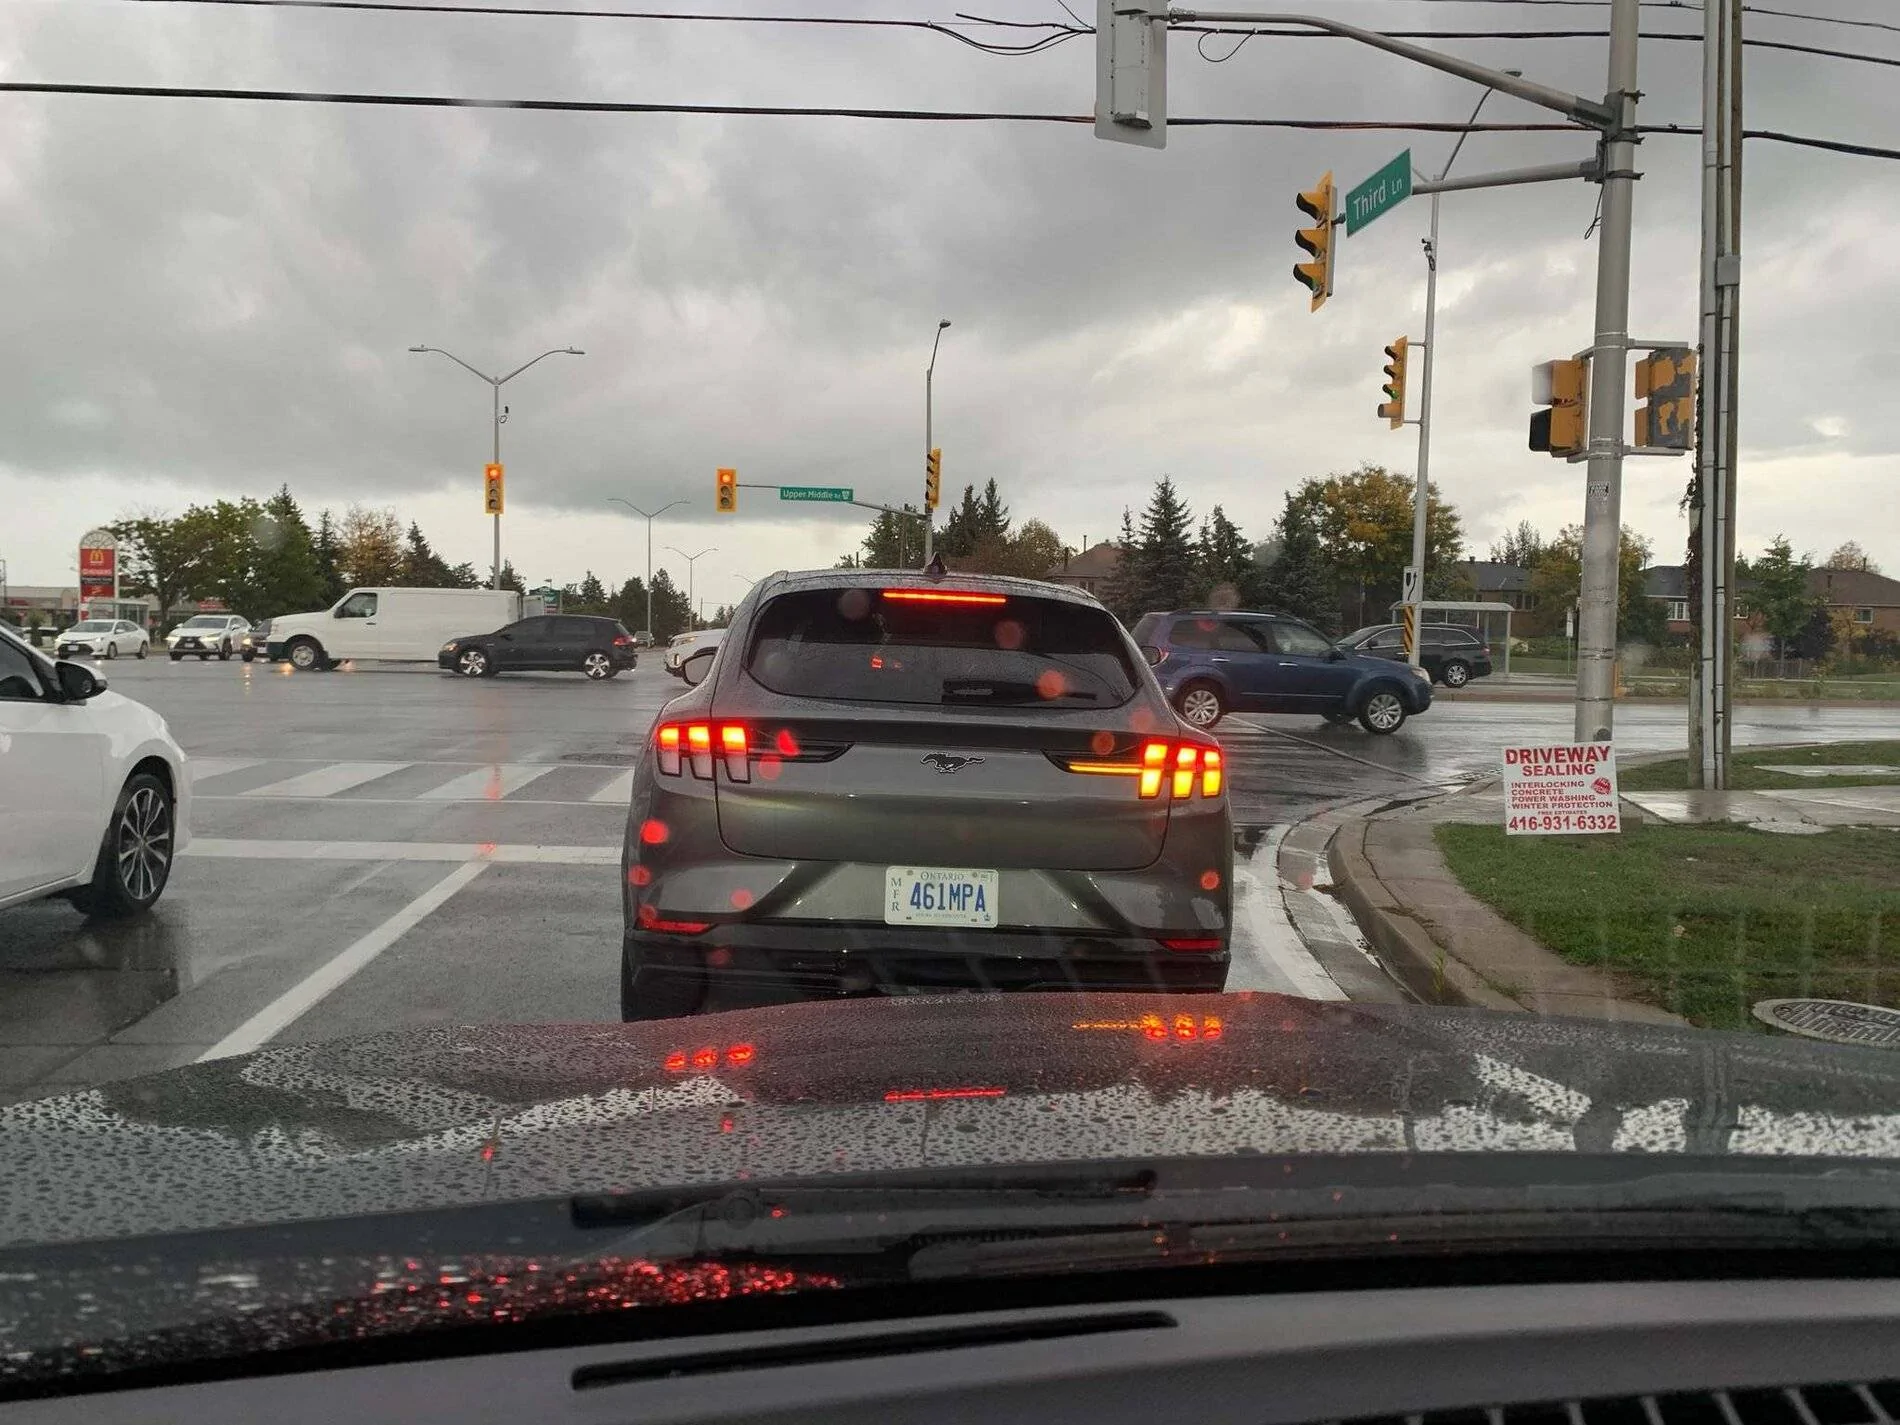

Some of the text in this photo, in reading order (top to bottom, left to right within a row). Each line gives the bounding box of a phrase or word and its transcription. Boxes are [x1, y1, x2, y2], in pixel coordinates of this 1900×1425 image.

[1353, 178, 1402, 220] Third Ln
[783, 490, 805, 499] Upper
[808, 490, 833, 500] Middle
[1505, 745, 1611, 765] DRIVEWAY
[1522, 764, 1596, 777] SEALING
[1511, 781, 1585, 789] INTERLOCKING
[1511, 788, 1564, 796] CONCRETE
[1511, 794, 1596, 803] POWER WASHING
[1511, 801, 1613, 810] WINTER PROTECTION
[1509, 815, 1617, 830] 416-931-6332
[920, 871, 965, 881] ONTARIO
[910, 881, 986, 912] 461MPA
